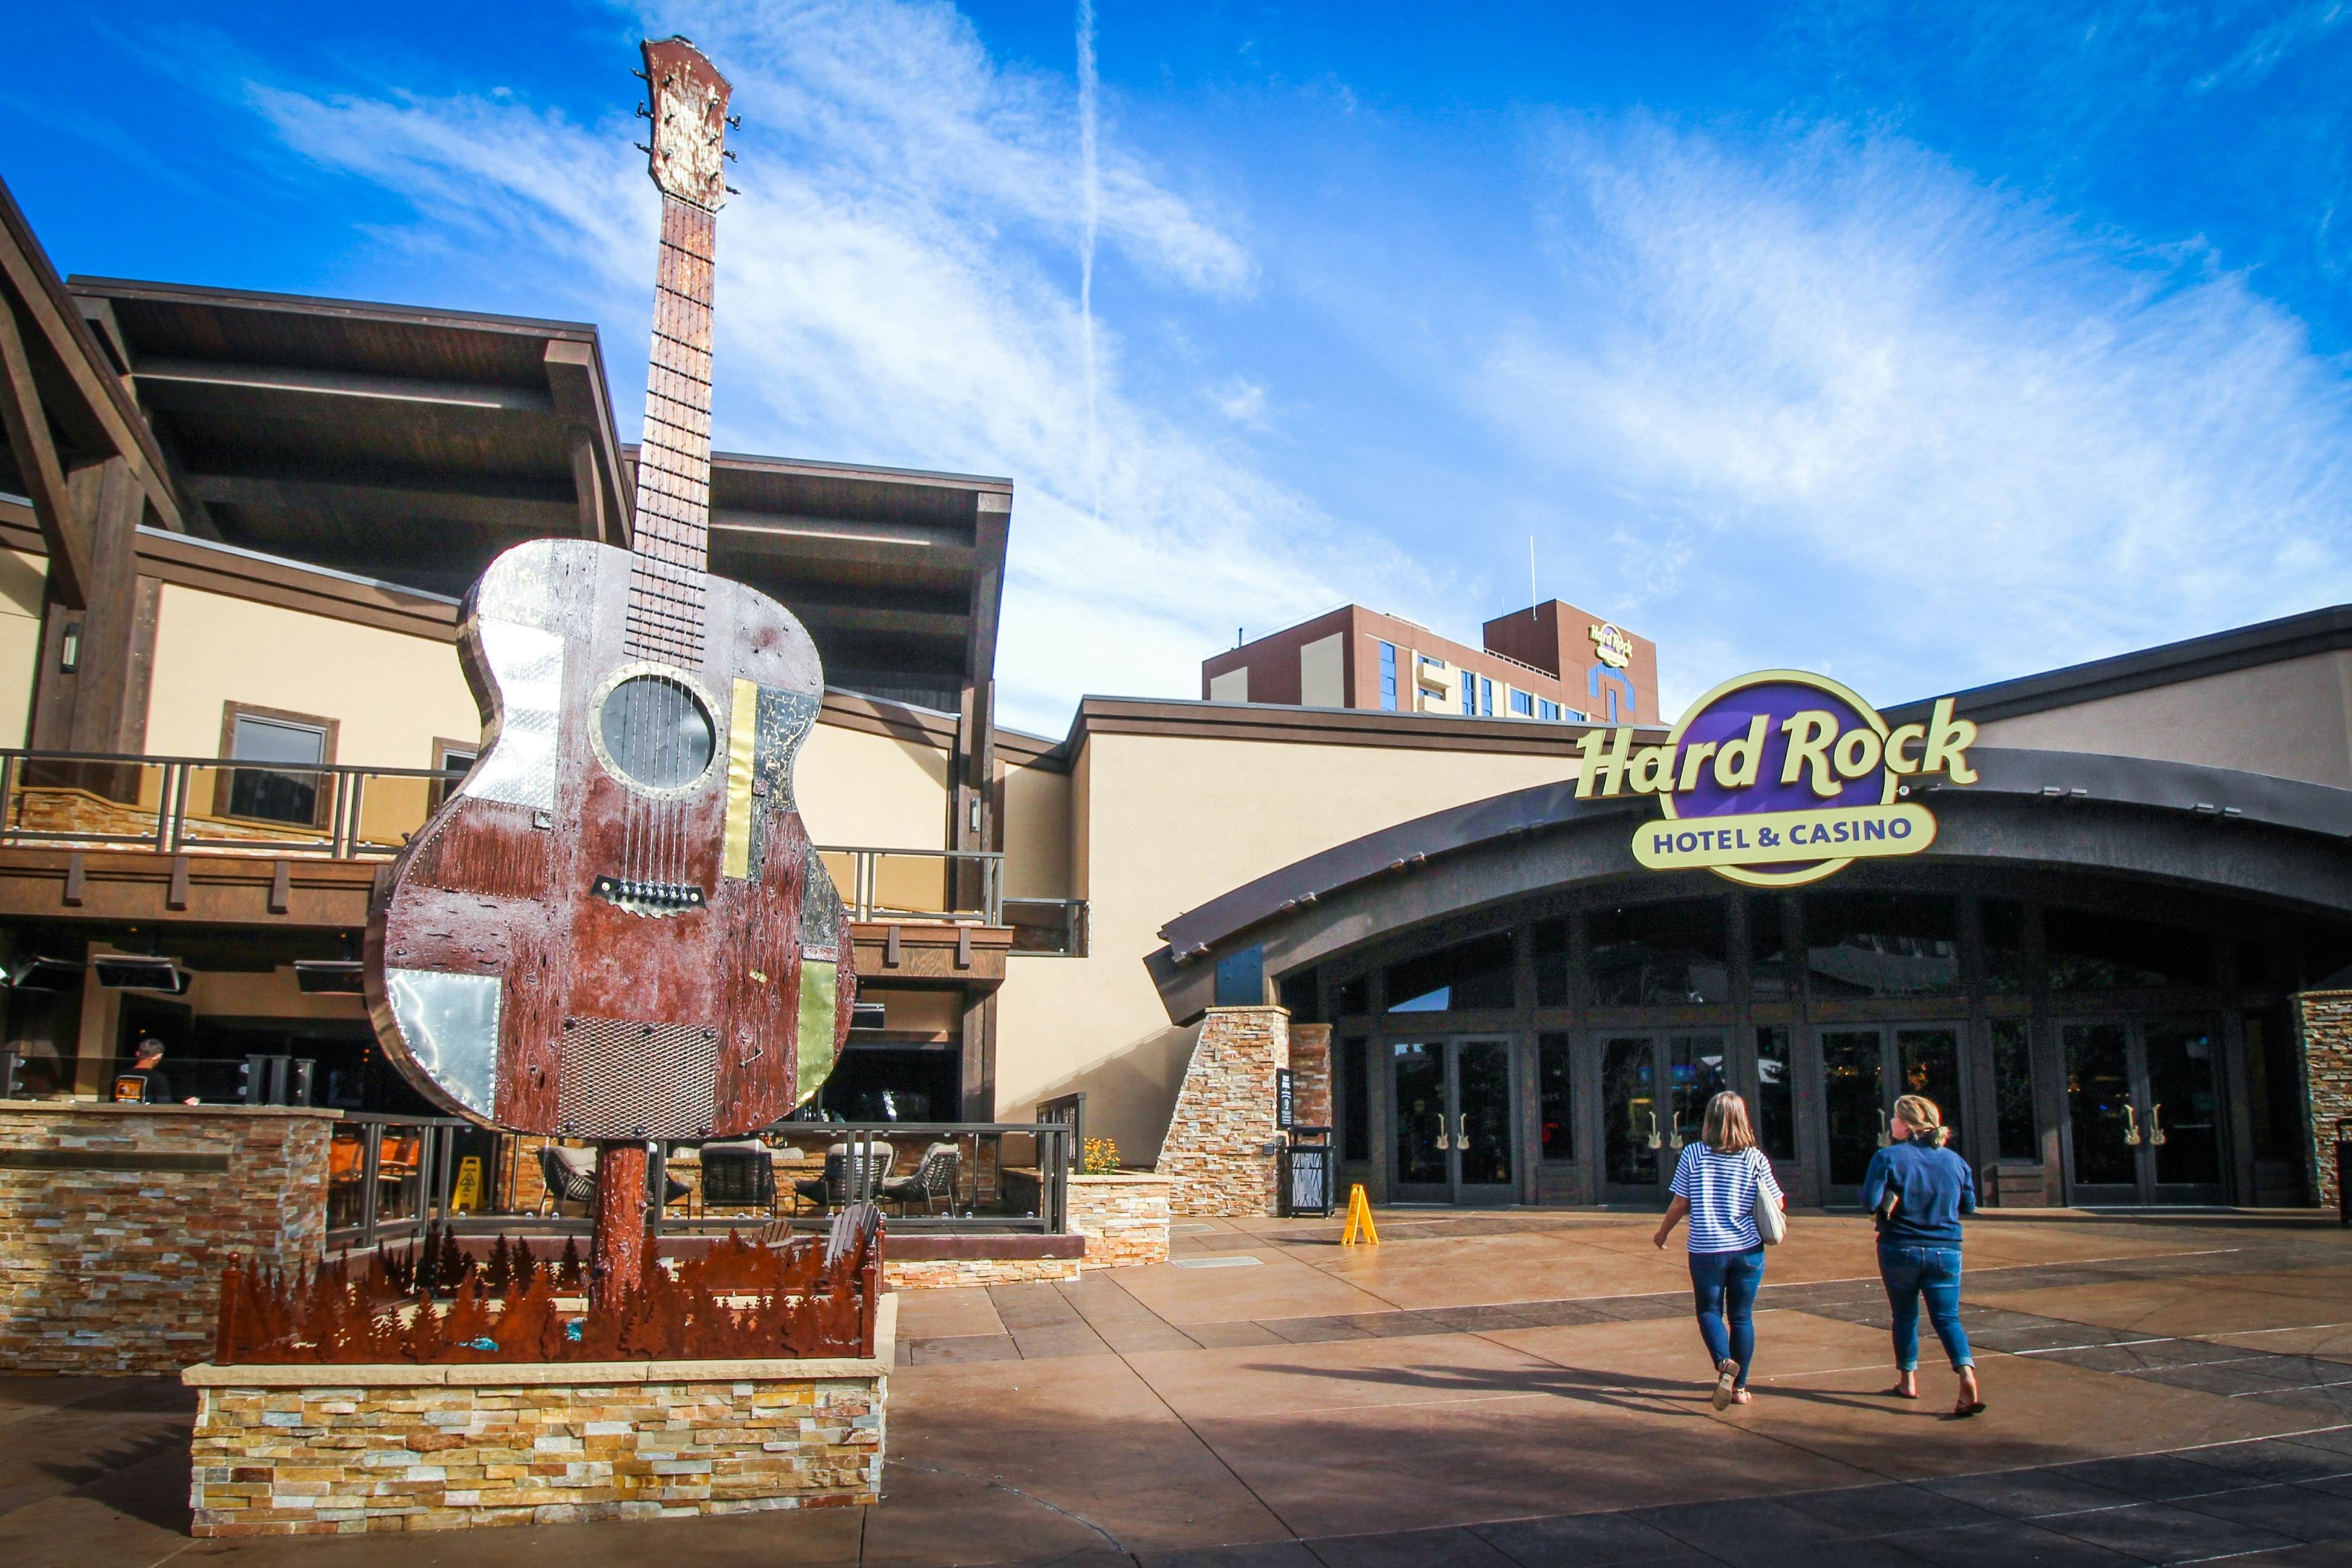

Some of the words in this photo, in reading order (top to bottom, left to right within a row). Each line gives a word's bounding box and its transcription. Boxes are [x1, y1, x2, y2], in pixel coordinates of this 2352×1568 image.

[1575, 714, 1770, 799] Hard
[1780, 697, 1979, 798] Rock
[1653, 829, 1750, 855] HOTEL
[1757, 827, 1780, 847] &
[1789, 817, 1912, 846] CASINO
